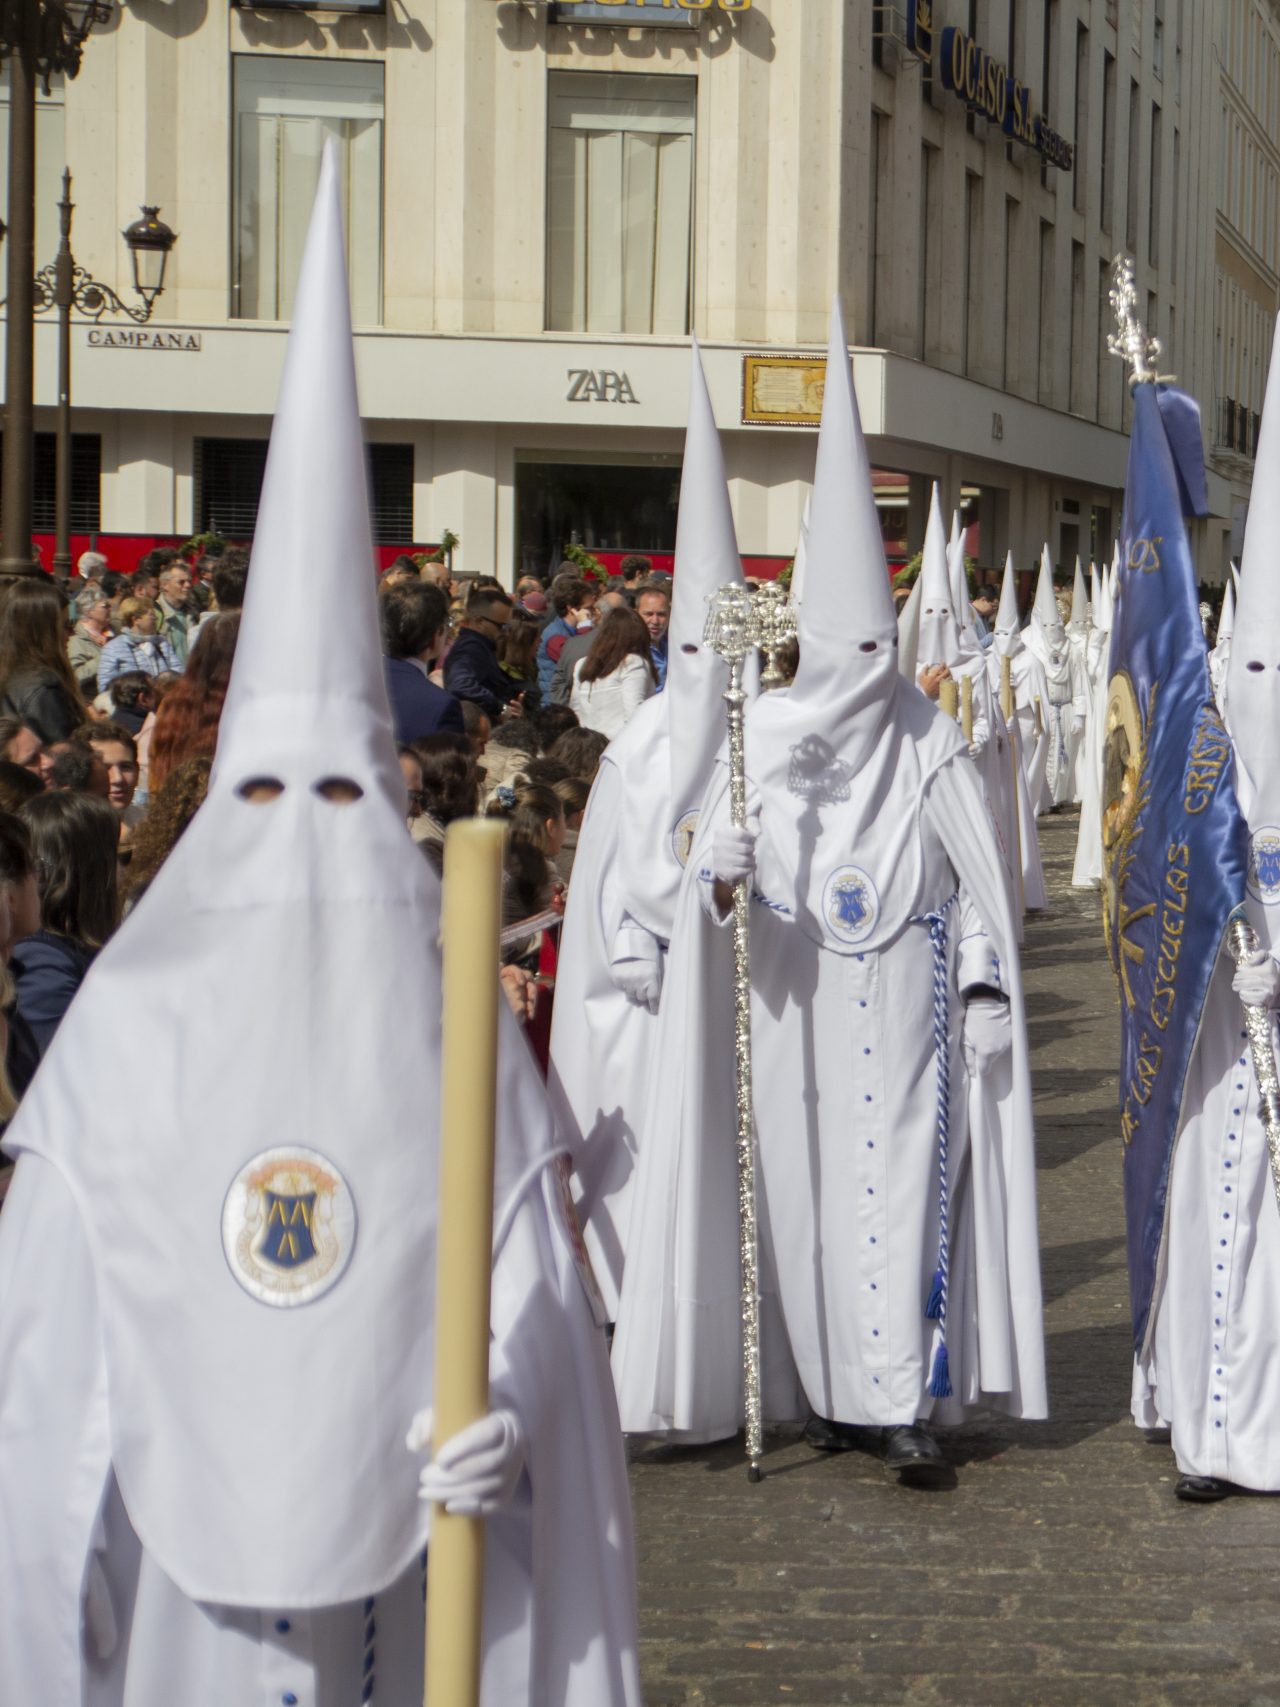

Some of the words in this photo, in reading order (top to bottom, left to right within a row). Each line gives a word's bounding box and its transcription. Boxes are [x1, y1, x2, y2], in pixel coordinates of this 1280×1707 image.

[951, 26, 1007, 124] OCASO
[87, 330, 199, 349] CAMPANA
[567, 369, 641, 405] ZARA
[1130, 1032, 1163, 1105] LAS
[1150, 843, 1190, 1031] ESCUELAS
